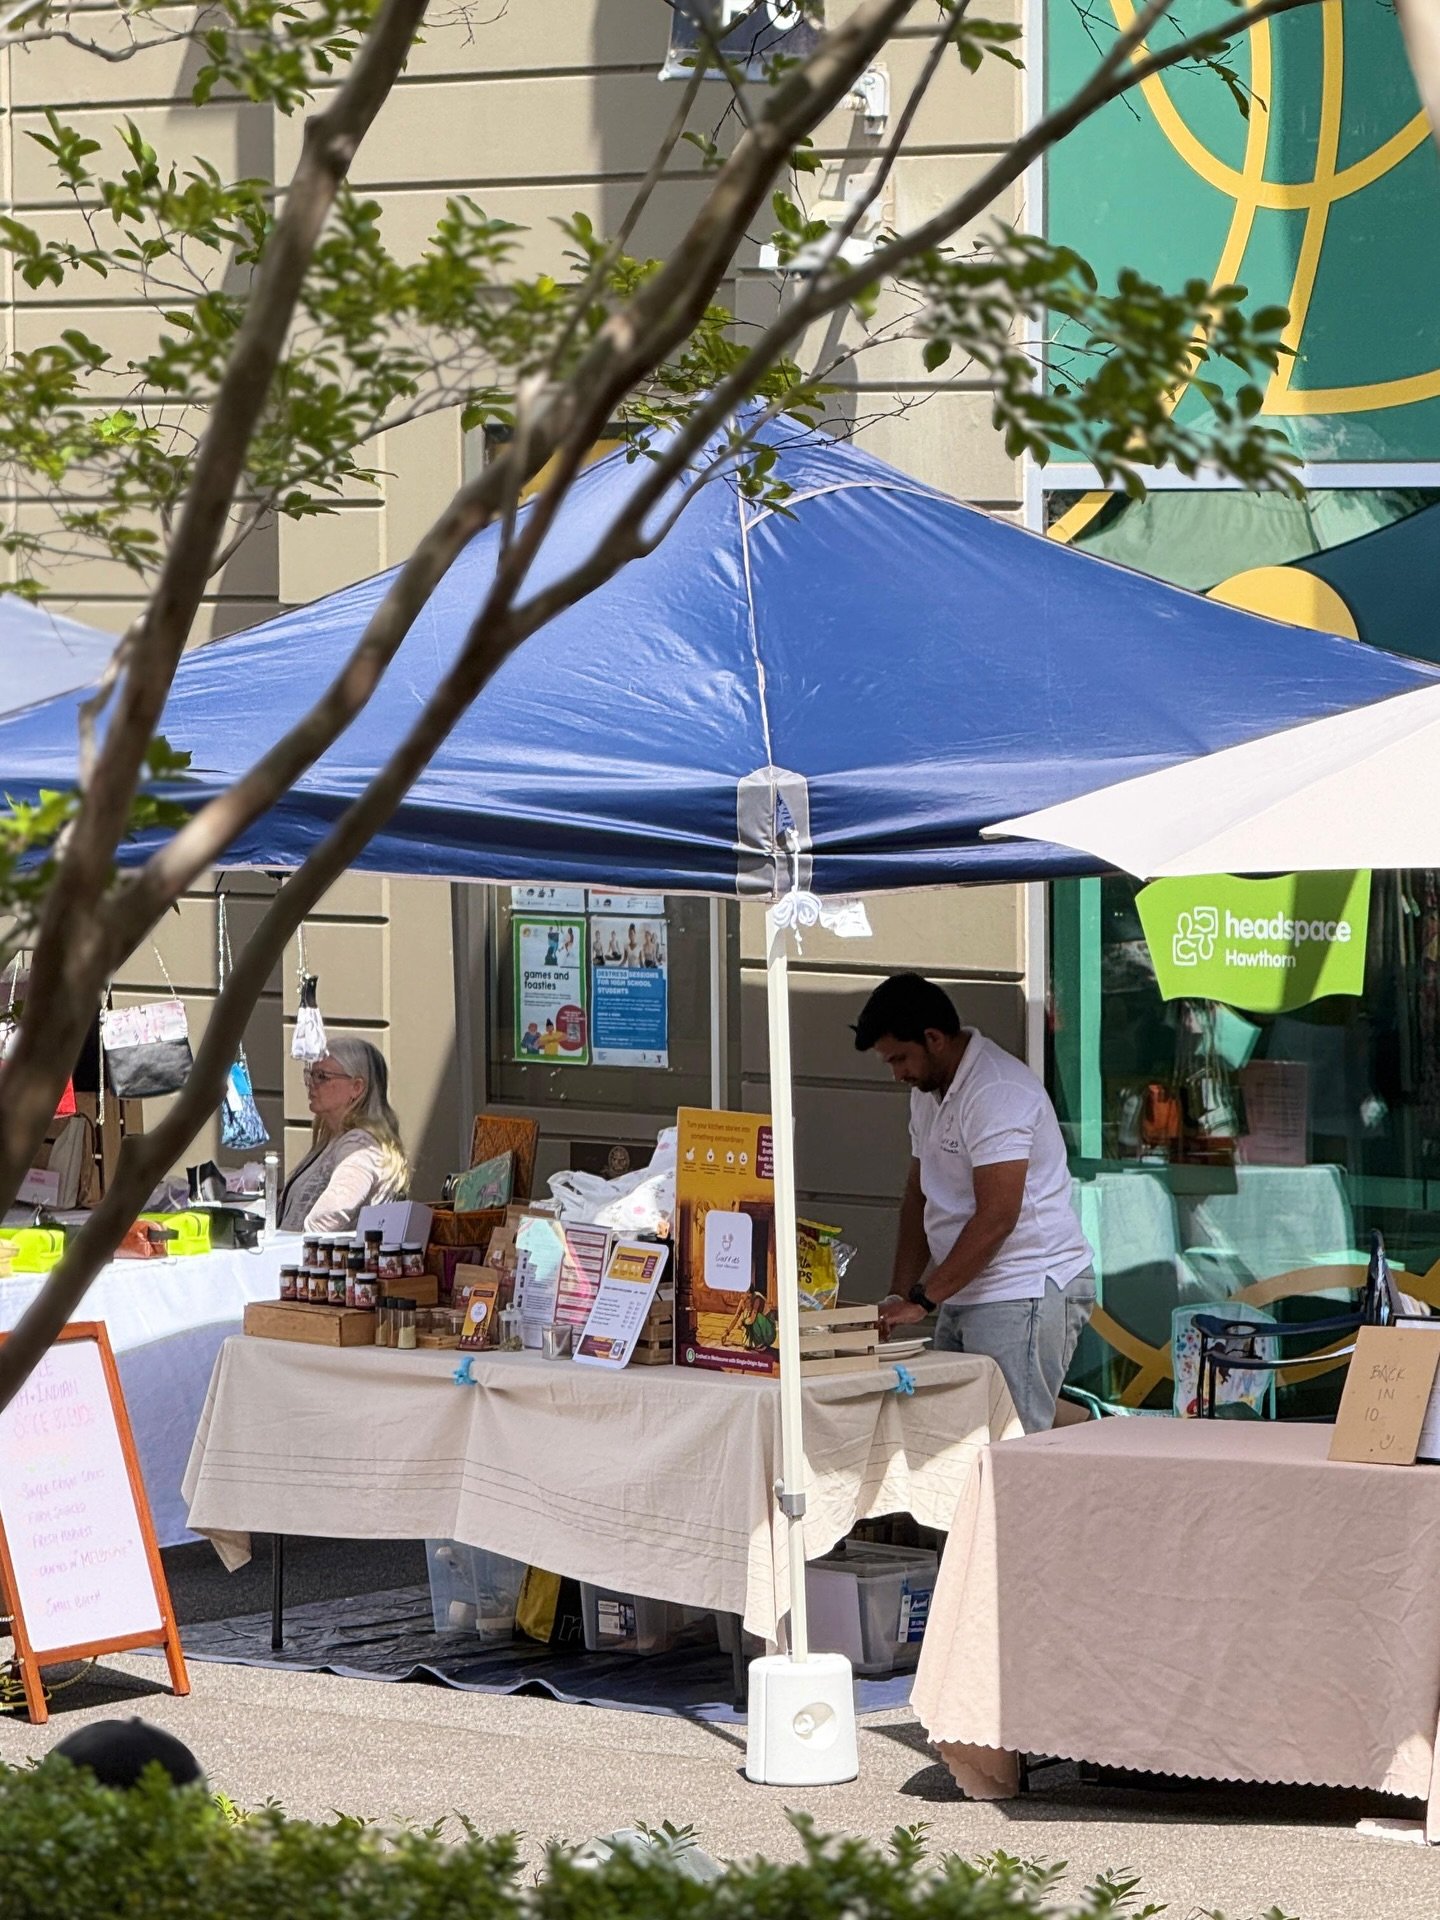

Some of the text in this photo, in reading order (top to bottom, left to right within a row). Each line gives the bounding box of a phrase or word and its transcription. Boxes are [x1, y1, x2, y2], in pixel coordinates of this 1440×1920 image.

[1225, 910, 1351, 947] headspace
[1225, 949, 1296, 968] Hawthorn
[524, 971, 569, 980] games and
[1369, 1365, 1407, 1384] BACK
[1378, 1388, 1396, 1401] IN
[1364, 1407, 1379, 1422] 10
